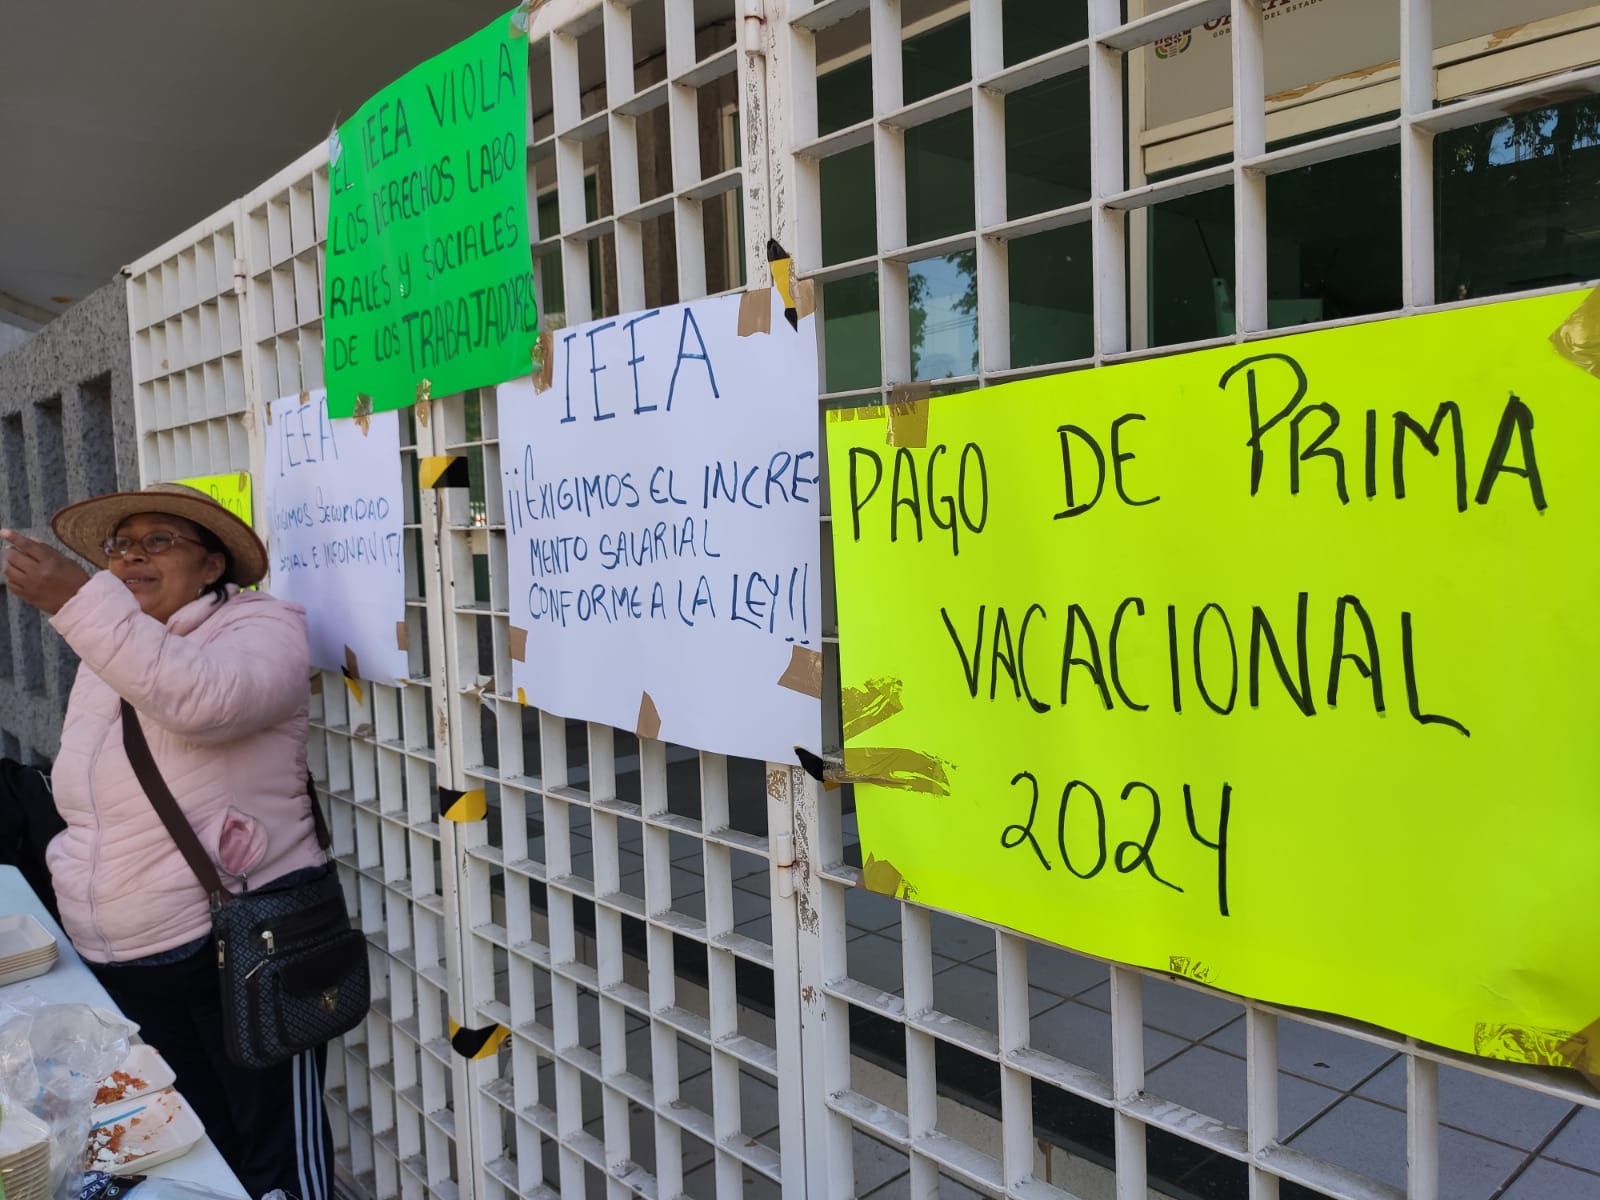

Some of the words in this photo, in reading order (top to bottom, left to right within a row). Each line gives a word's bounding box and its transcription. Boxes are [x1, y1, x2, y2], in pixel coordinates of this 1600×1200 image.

[1264, 11, 1281, 21] DEL
[1286, 0, 1322, 13] ESTAD
[362, 98, 412, 174] IEEA
[426, 42, 516, 127] VIOLA
[333, 204, 368, 256] LOS
[373, 156, 455, 236] DERECHOS
[467, 132, 516, 193] LABO
[330, 264, 392, 319] RALES
[423, 206, 519, 281] SOCIALES
[333, 335, 360, 372] DE
[374, 321, 400, 363] LOS
[402, 271, 539, 374] TRABAJADORES
[559, 307, 720, 424] IEEA
[650, 465, 688, 505] EL
[849, 441, 988, 556] PAGO
[1053, 413, 1161, 521] DE
[1219, 353, 1548, 516] PRIMA
[528, 582, 642, 628] CONFORME
[678, 574, 716, 627] LA
[530, 535, 588, 578] MENTO
[600, 516, 721, 570] SALARIAL
[940, 591, 1472, 738] VACACIONAL
[1000, 771, 1233, 918] 2024
